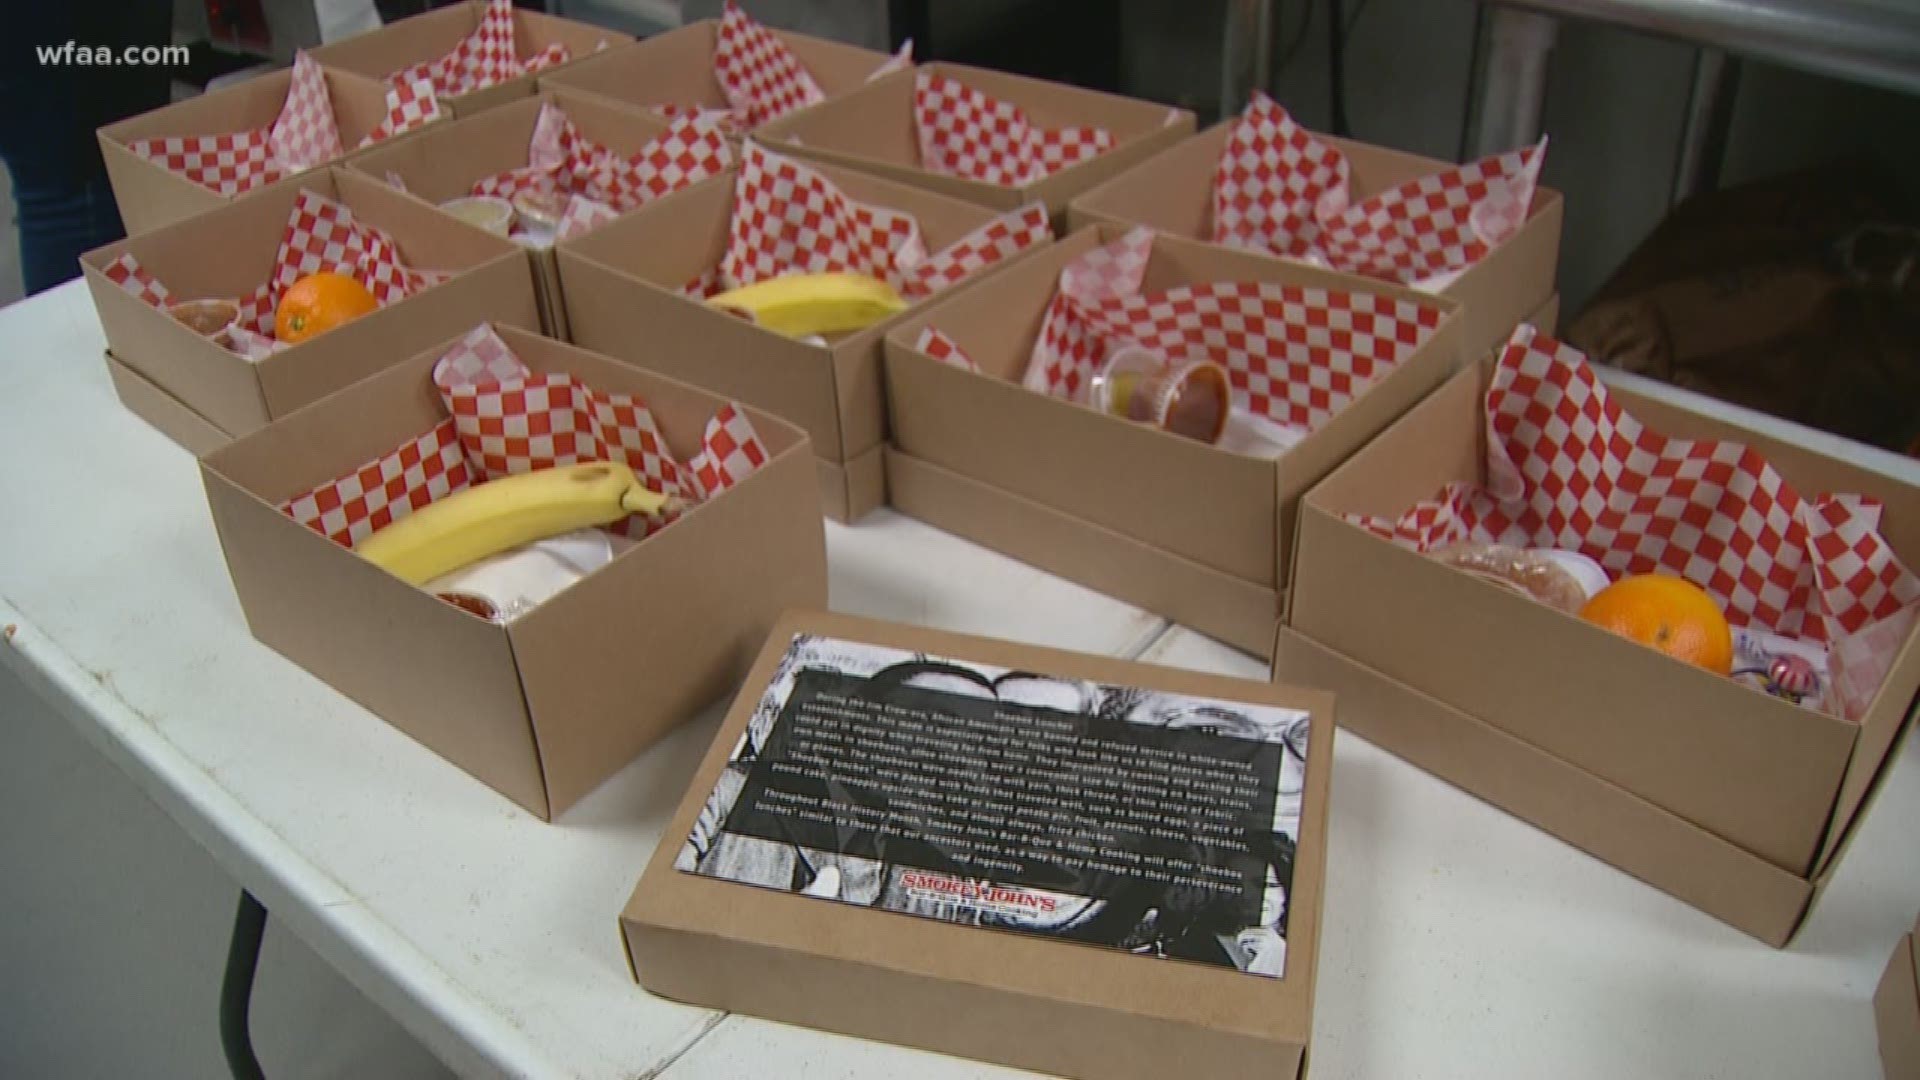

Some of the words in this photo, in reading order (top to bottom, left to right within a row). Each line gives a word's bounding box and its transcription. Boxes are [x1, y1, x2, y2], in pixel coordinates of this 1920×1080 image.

[848, 699, 865, 707] the
[931, 713, 965, 724] African
[967, 719, 1015, 733] Americans
[1018, 729, 1040, 737] were
[1043, 731, 1079, 743] banned
[1101, 742, 1138, 752] refused
[1140, 747, 1174, 758] service
[1177, 751, 1187, 760] in
[1190, 755, 1252, 770] white-owned
[876, 715, 896, 725] This
[898, 721, 923, 729] made
[925, 724, 934, 732] it
[935, 728, 984, 742] especially
[986, 734, 1009, 744] hard
[1010, 738, 1024, 747] for
[1027, 741, 1051, 751] folks
[1054, 746, 1073, 755] who
[1076, 748, 1098, 758] look
[1100, 752, 1118, 762] like
[1135, 758, 1146, 766] to
[1149, 760, 1169, 770] find
[1171, 764, 1202, 775] places
[1206, 770, 1234, 780] where
[1239, 774, 1259, 786] they
[993, 711, 1032, 724] Shoebox
[1035, 718, 1074, 731] Lunches
[792, 727, 813, 735] own
[814, 731, 843, 740] meals
[844, 734, 855, 742] in
[910, 748, 936, 758] since
[938, 752, 988, 766] shoeboxes
[991, 762, 1015, 771] were
[1026, 768, 1079, 782] convenient
[1082, 775, 1102, 785] size
[1105, 778, 1119, 787] for
[1122, 781, 1167, 797] traveling
[1170, 790, 1183, 798] on
[795, 715, 822, 724] could
[840, 721, 851, 729] in
[888, 731, 914, 741] when
[915, 735, 959, 750] traveling
[961, 743, 975, 751] far
[977, 745, 1001, 756] from
[1036, 755, 1058, 767] They
[1116, 767, 1128, 778] by
[1131, 771, 1169, 785] cooking
[1173, 778, 1190, 786] and
[1193, 781, 1231, 794] packing
[1235, 786, 1258, 797] their
[850, 749, 868, 758] The
[869, 753, 919, 767] shoeboxes
[921, 764, 945, 772] were
[947, 768, 979, 780] neatly
[980, 772, 1002, 782] tied
[1003, 777, 1026, 786] with
[1056, 784, 1081, 795] thick
[1136, 797, 1156, 807] thin
[1159, 801, 1188, 813] strips
[1191, 806, 1202, 814] of
[771, 763, 803, 773] pound
[829, 774, 880, 788] pineapple
[946, 795, 969, 804] cake
[984, 802, 1014, 812] sweet
[1015, 807, 1050, 818] potato
[876, 769, 900, 778] were
[900, 774, 937, 785] packed
[939, 780, 962, 789] with
[963, 782, 991, 794] foods
[992, 788, 1014, 798] that
[1016, 792, 1058, 805] traveled
[1089, 804, 1112, 814] such
[1128, 809, 1161, 822] boiled
[1202, 822, 1229, 833] piece
[1233, 827, 1244, 835] of
[950, 810, 969, 818] and
[971, 812, 1005, 824] almost
[1048, 824, 1073, 836] fried
[763, 788, 819, 805] Throughout
[820, 799, 848, 811] Black
[850, 804, 887, 820] History
[926, 818, 964, 834] Smokey
[966, 825, 997, 838] John's
[1056, 839, 1064, 848] &
[1067, 841, 1096, 854] Home
[1099, 847, 1140, 864] Cooking
[1144, 856, 1164, 865] will
[1167, 859, 1192, 870] offer
[799, 810, 833, 822] similar
[835, 816, 848, 825] to
[848, 819, 877, 830] those
[878, 824, 901, 835] that
[903, 830, 920, 838] our
[923, 833, 971, 847] ancestors
[1004, 847, 1017, 855] as
[1018, 849, 1026, 857] a
[1027, 851, 1049, 863] way
[1051, 854, 1063, 863] to
[1064, 857, 1084, 869] pay
[1087, 859, 1127, 875] homage
[1130, 867, 1141, 876] to
[1145, 869, 1170, 881] their
[1173, 875, 1242, 893] perseverance
[951, 853, 971, 862] and
[902, 873, 984, 899] SMOKEY
[985, 886, 1057, 912] JOHN'S
